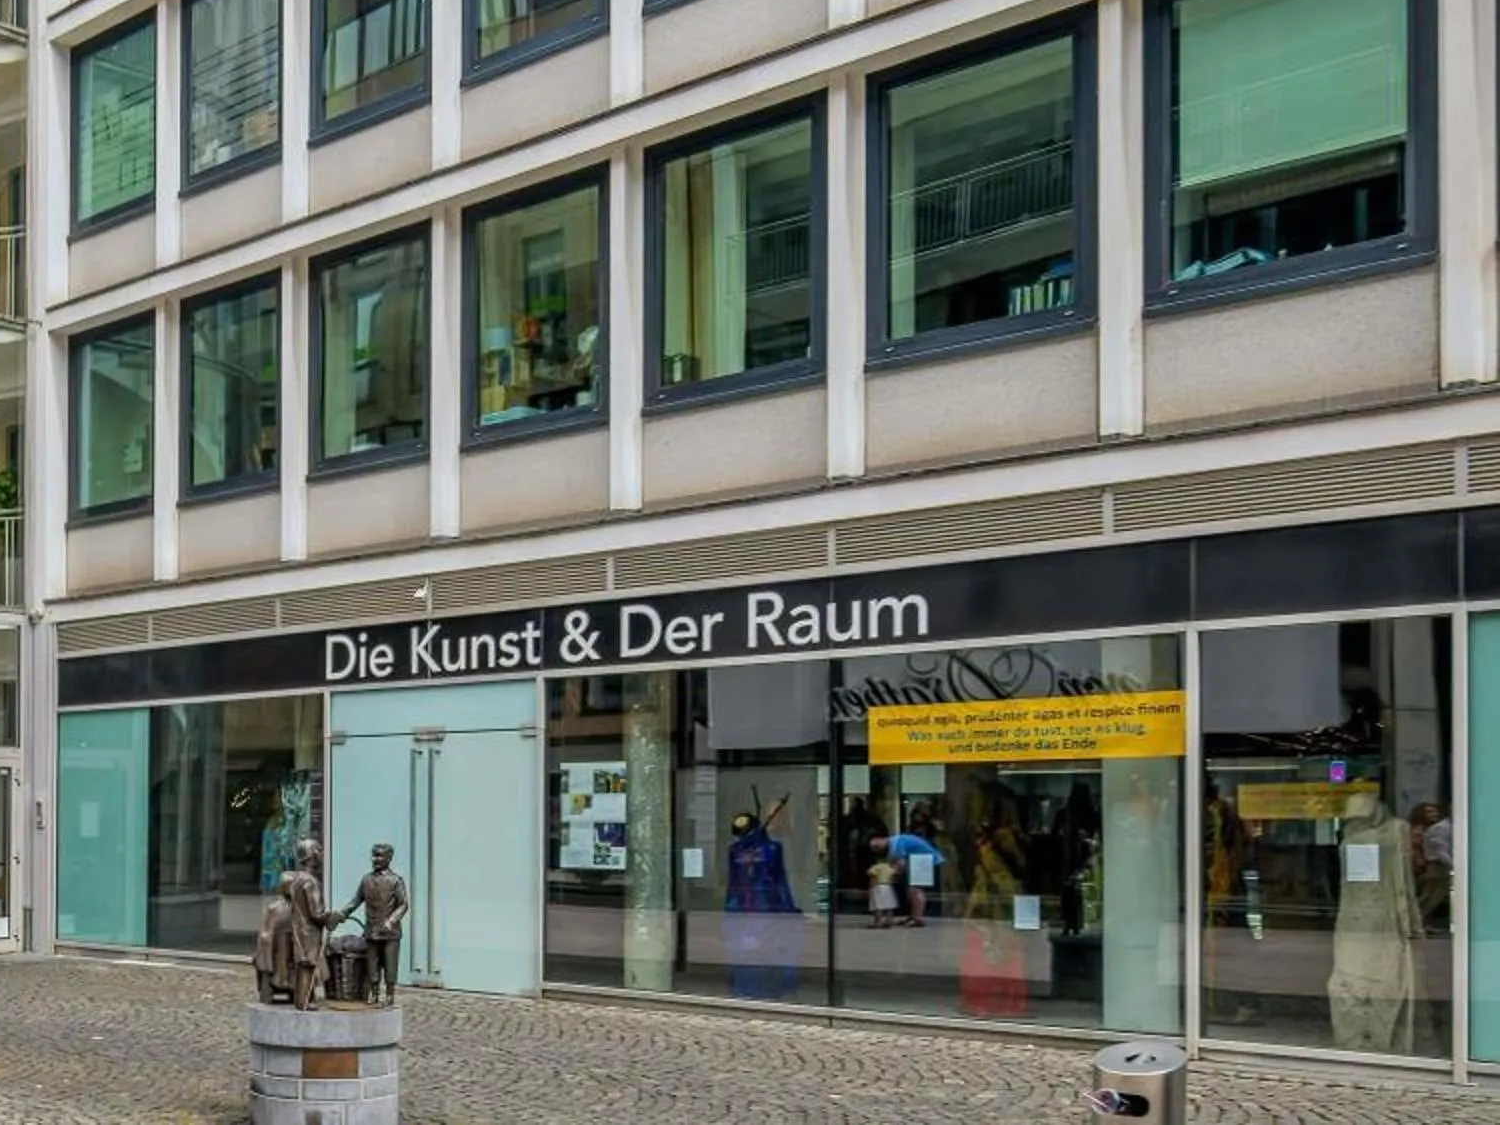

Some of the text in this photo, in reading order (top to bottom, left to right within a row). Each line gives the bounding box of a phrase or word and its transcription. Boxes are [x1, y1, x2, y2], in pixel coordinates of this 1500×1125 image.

[325, 591, 929, 681] Die Kunst & Der Raum
[1138, 703, 1181, 715] finem
[1034, 739, 1060, 750] das
[1062, 738, 1097, 750] Ende
